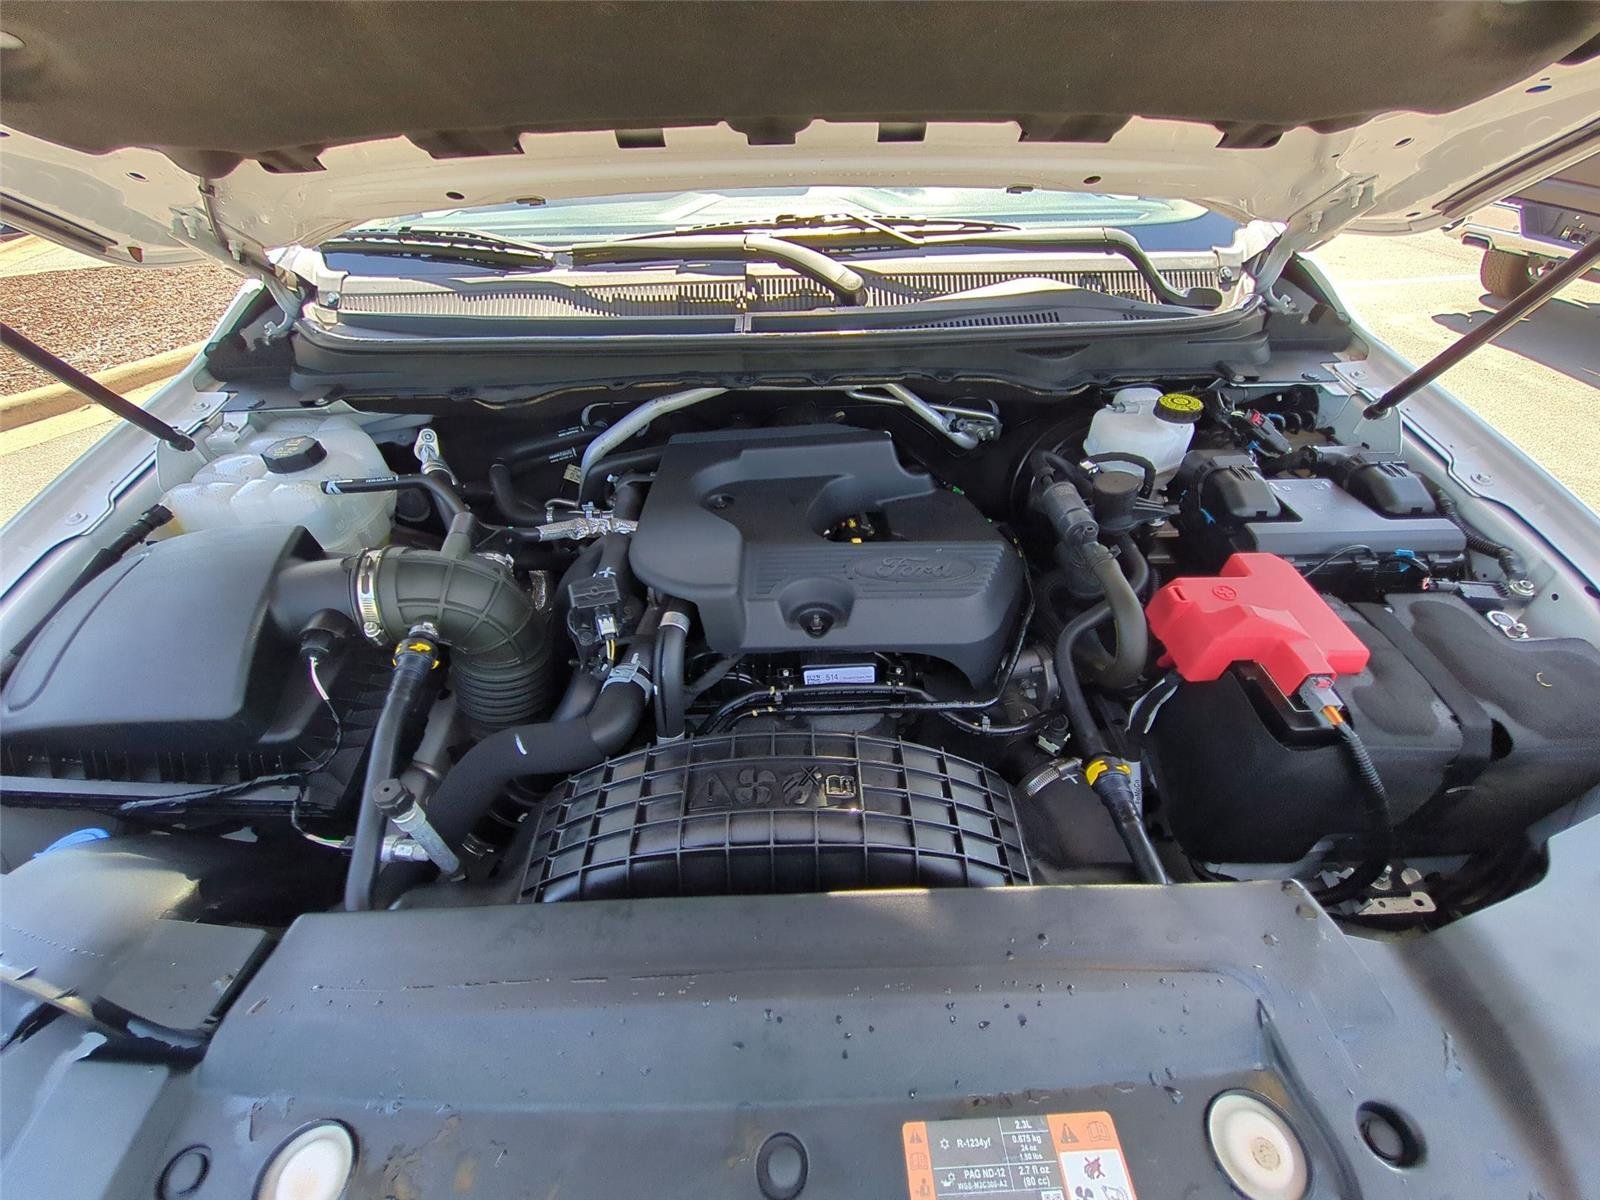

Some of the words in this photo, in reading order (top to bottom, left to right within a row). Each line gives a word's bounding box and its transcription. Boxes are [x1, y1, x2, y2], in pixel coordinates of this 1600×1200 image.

[876, 557, 952, 578] Ford
[825, 673, 840, 682] 514
[1014, 1120, 1032, 1130] 2.3L
[957, 1137, 991, 1149] R-1234yf
[1031, 1134, 1042, 1144] kg
[964, 1169, 981, 1179] PAG
[982, 1168, 1006, 1178] ND-12
[1018, 1166, 1031, 1175] 2.7
[1032, 1166, 1038, 1174] fl
[1023, 1176, 1036, 1187] (80
[1037, 1175, 1051, 1187] cc)
